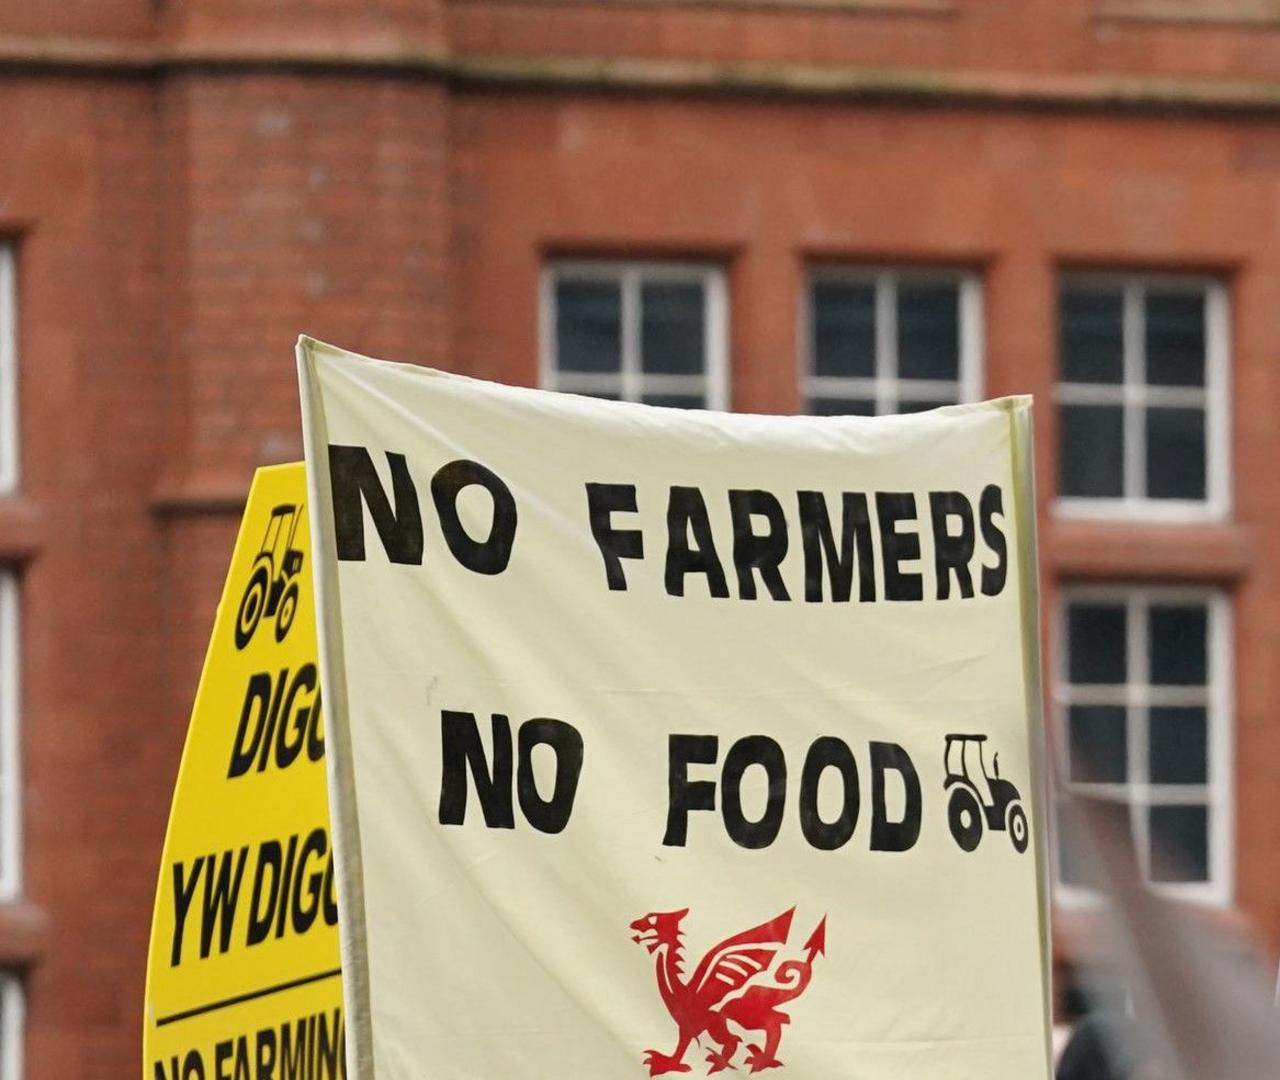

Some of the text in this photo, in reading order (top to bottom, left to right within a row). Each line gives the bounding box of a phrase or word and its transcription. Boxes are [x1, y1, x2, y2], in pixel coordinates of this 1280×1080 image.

[328, 444, 1008, 603] NO FARMERS
[438, 709, 923, 852] NO FOOD
[171, 845, 249, 967] YW
